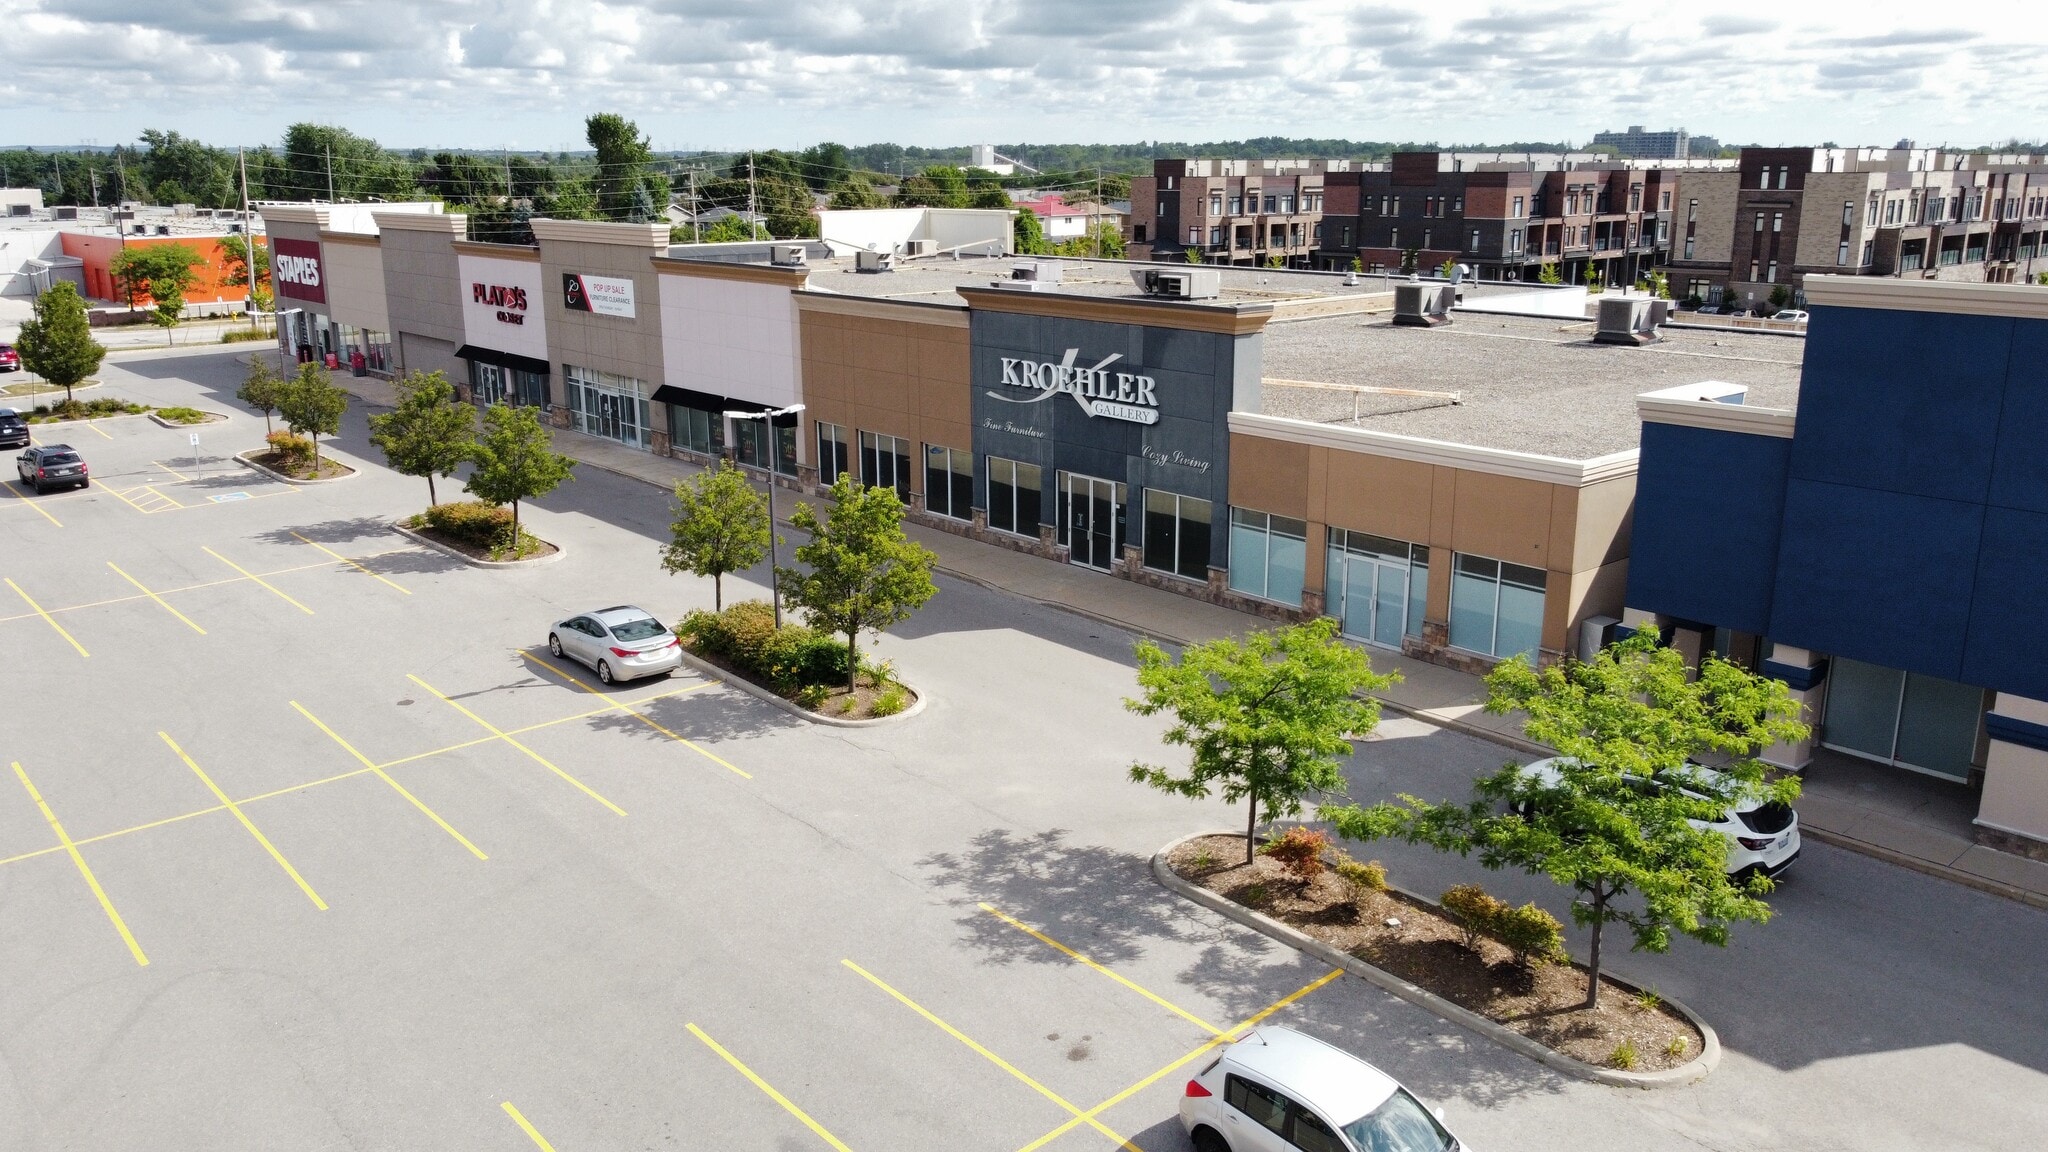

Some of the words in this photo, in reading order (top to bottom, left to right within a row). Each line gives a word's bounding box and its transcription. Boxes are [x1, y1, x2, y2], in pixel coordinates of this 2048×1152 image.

[277, 254, 320, 287] STAPLES
[472, 282, 528, 311] PLATO'S
[593, 283, 604, 292] POP
[604, 285, 612, 293] UP
[612, 286, 625, 295] SALE
[609, 296, 631, 305] CLEARANCE
[1000, 357, 1160, 407] KROEHLER
[1095, 402, 1151, 423] GALLERY
[983, 417, 1003, 431] Fine
[1004, 421, 1047, 439] Furniture
[1141, 444, 1169, 467] Cozy
[1172, 450, 1211, 475] Living
